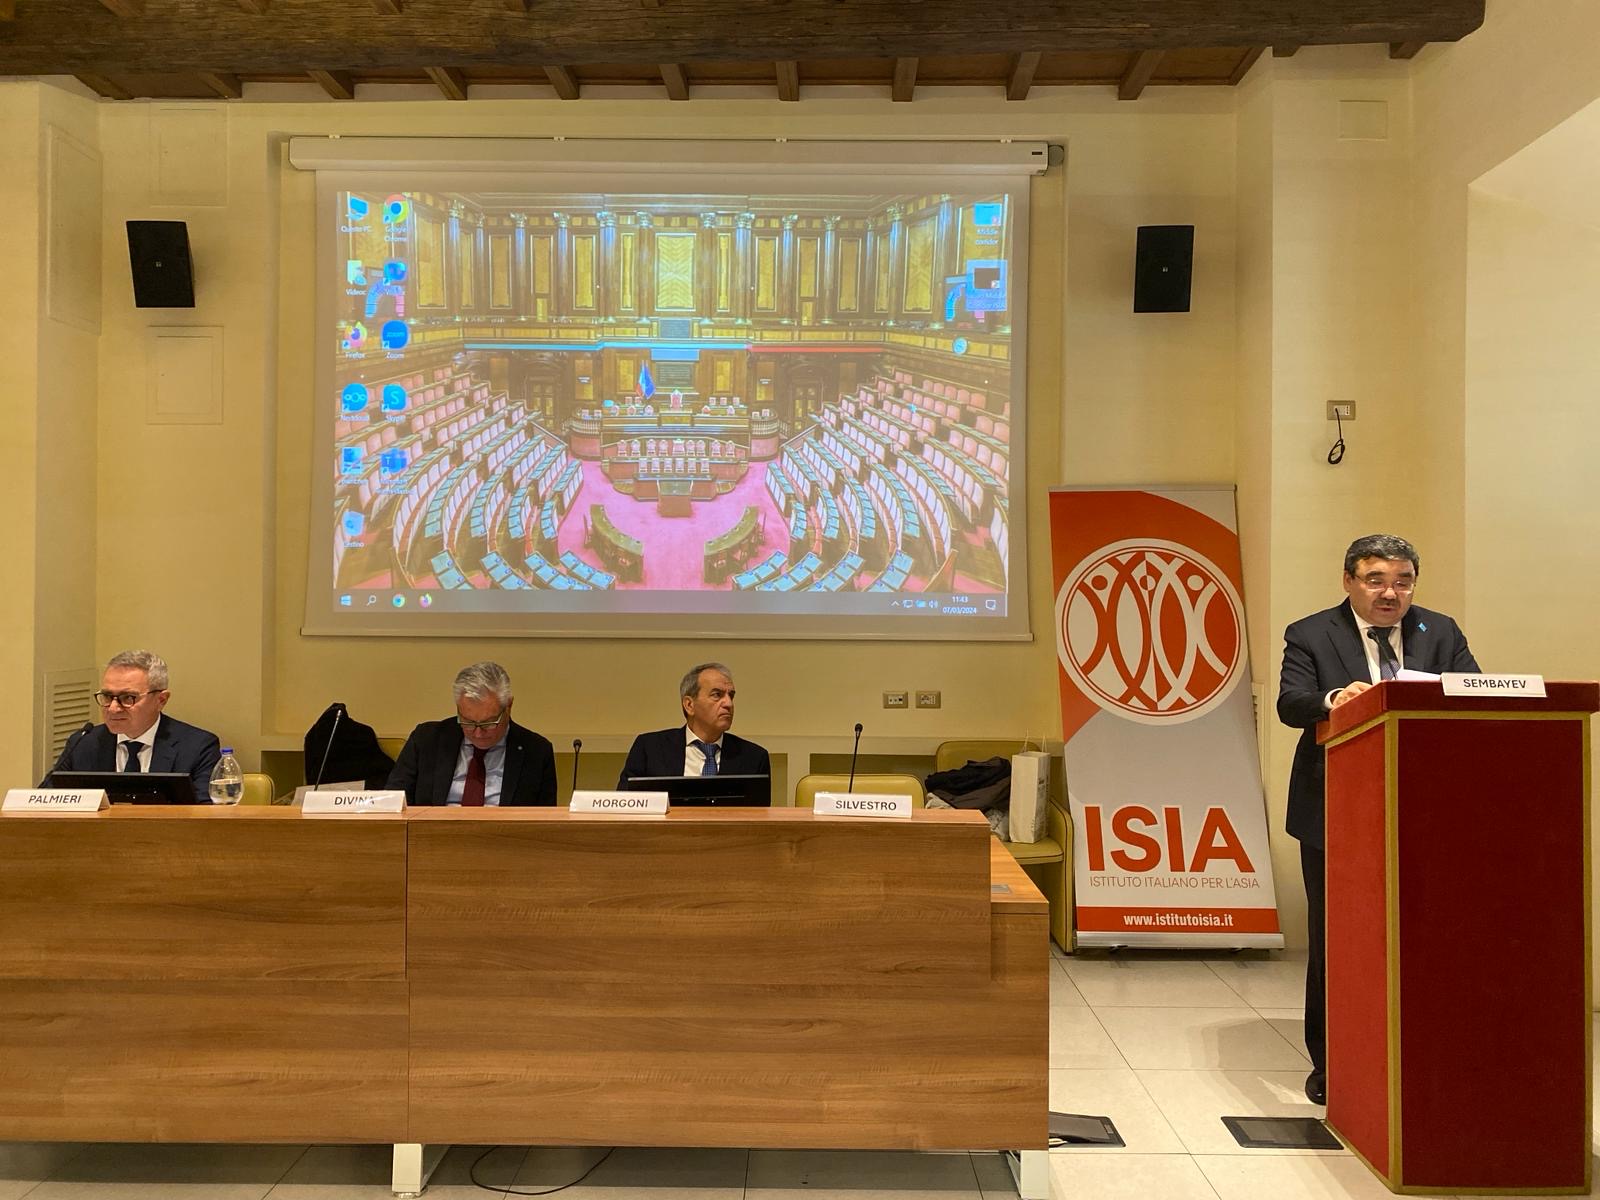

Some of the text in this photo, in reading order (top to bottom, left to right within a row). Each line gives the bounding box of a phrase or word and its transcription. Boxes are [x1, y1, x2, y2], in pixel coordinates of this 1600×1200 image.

[1463, 678, 1526, 689] SEMBAYEV
[28, 794, 82, 804] PALMIERI
[592, 799, 649, 808] MORGONI
[835, 800, 897, 811] SILVESTRO
[1084, 805, 1256, 873] ISIA
[1089, 876, 1260, 889] ISTITUTO ITALIANO PER L'ASIA
[1123, 913, 1234, 926] www.istitutoisia.it
